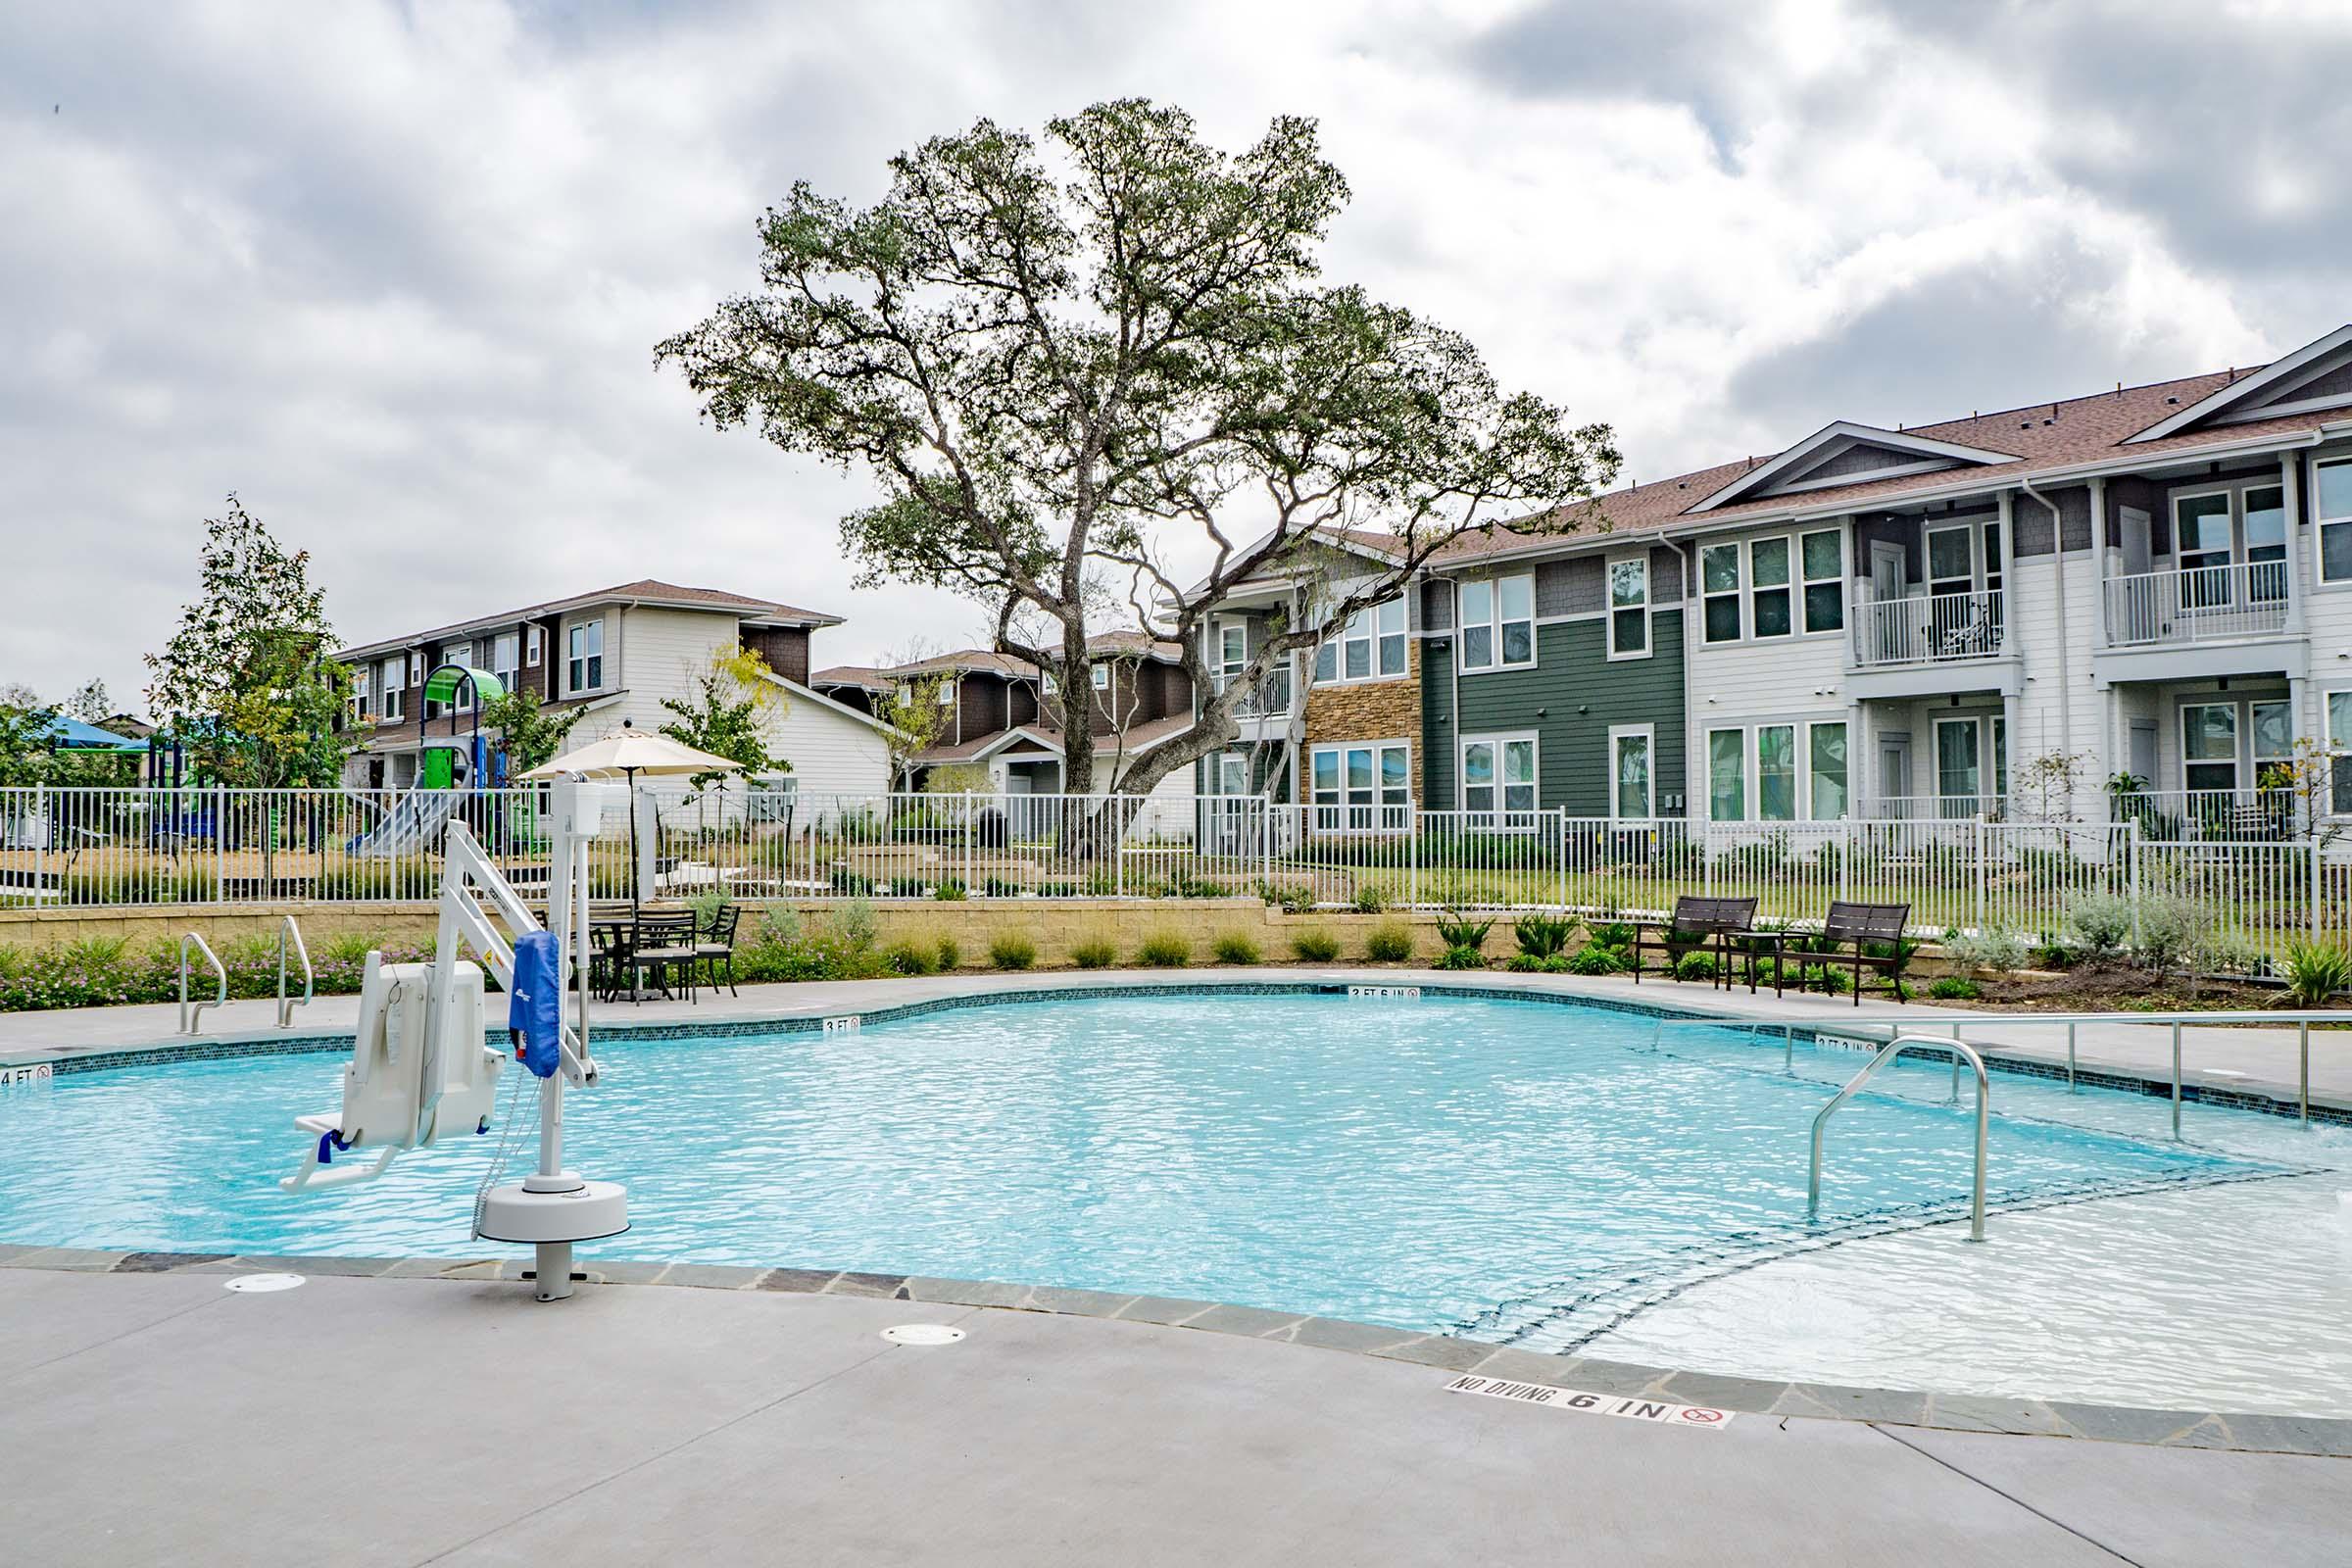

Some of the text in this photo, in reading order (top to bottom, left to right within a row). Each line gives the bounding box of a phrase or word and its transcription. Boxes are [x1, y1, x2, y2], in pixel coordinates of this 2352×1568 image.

[826, 1019, 848, 1030] 3 FT
[1, 1069, 32, 1084] 4 FT
[1449, 1376, 1667, 1419] NO DIVING 6 IN
